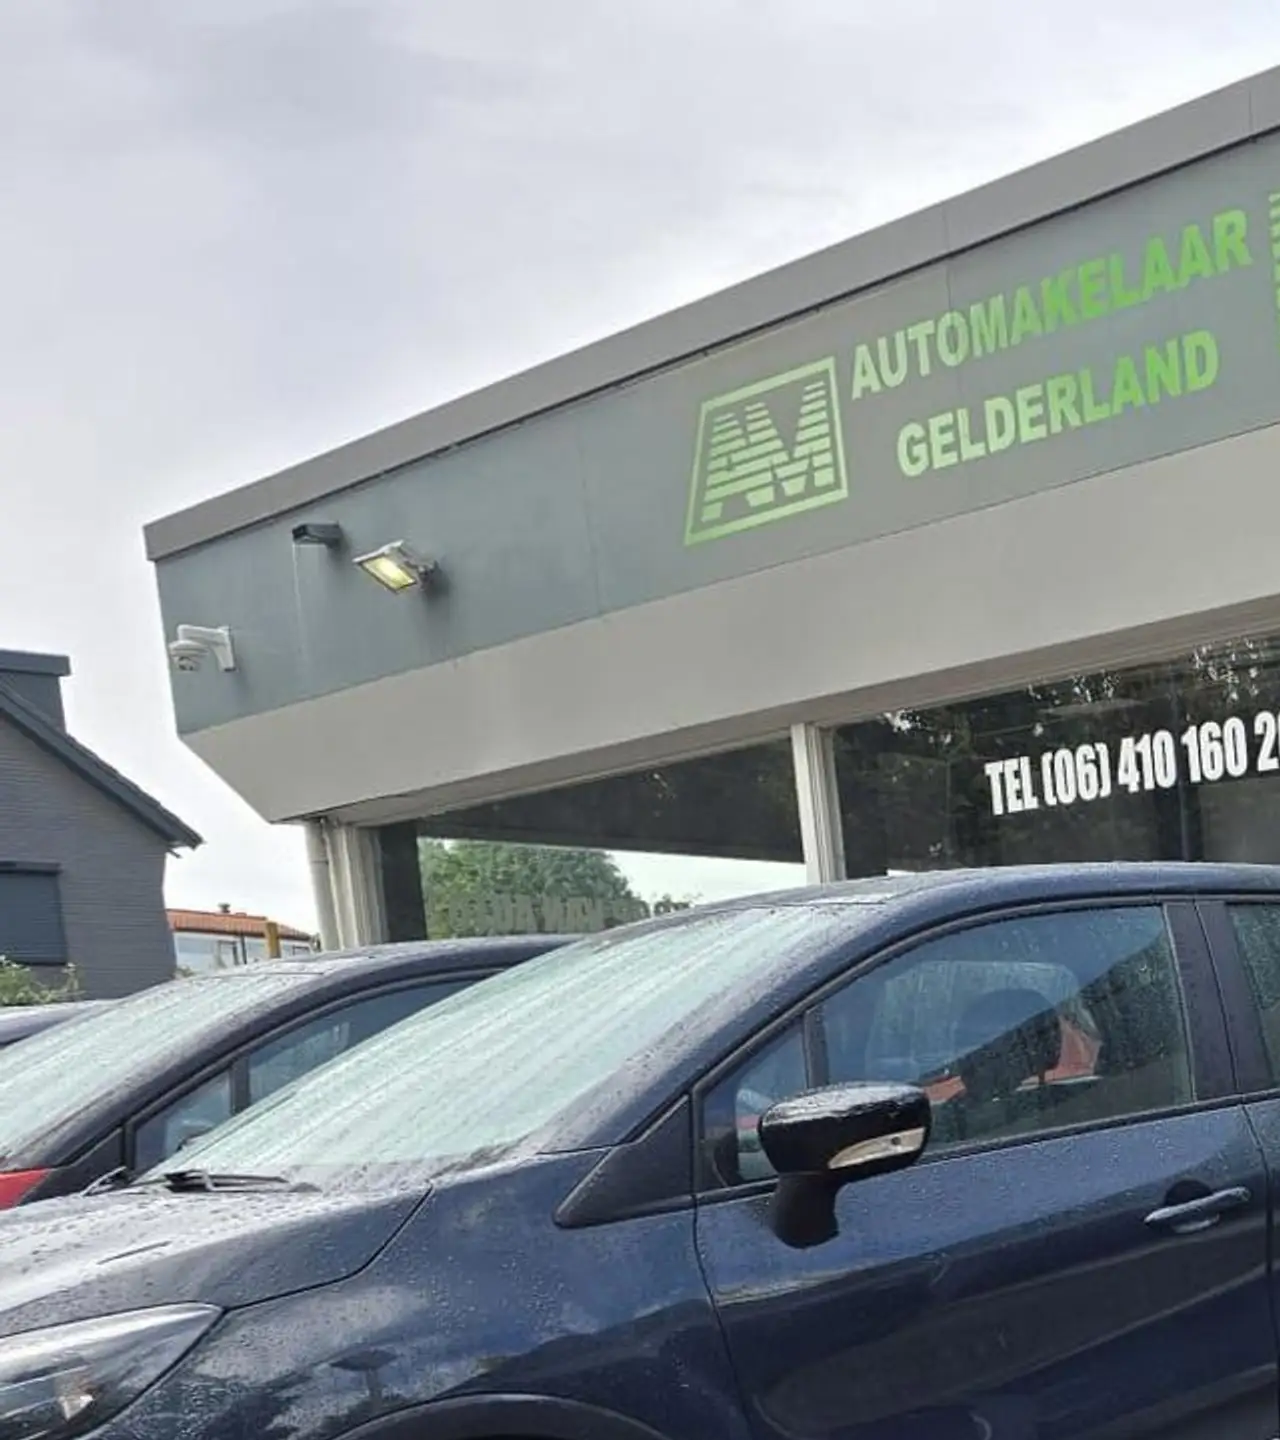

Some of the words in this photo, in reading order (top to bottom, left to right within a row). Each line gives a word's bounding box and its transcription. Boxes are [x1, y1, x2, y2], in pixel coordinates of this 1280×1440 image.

[851, 208, 1252, 400] AUTOMAKELAAR
[896, 330, 1219, 478] GELDERLAND
[984, 756, 1040, 816] TEL
[1040, 742, 1112, 807] (06)
[1117, 729, 1177, 794] 410
[1181, 716, 1248, 783] 160
